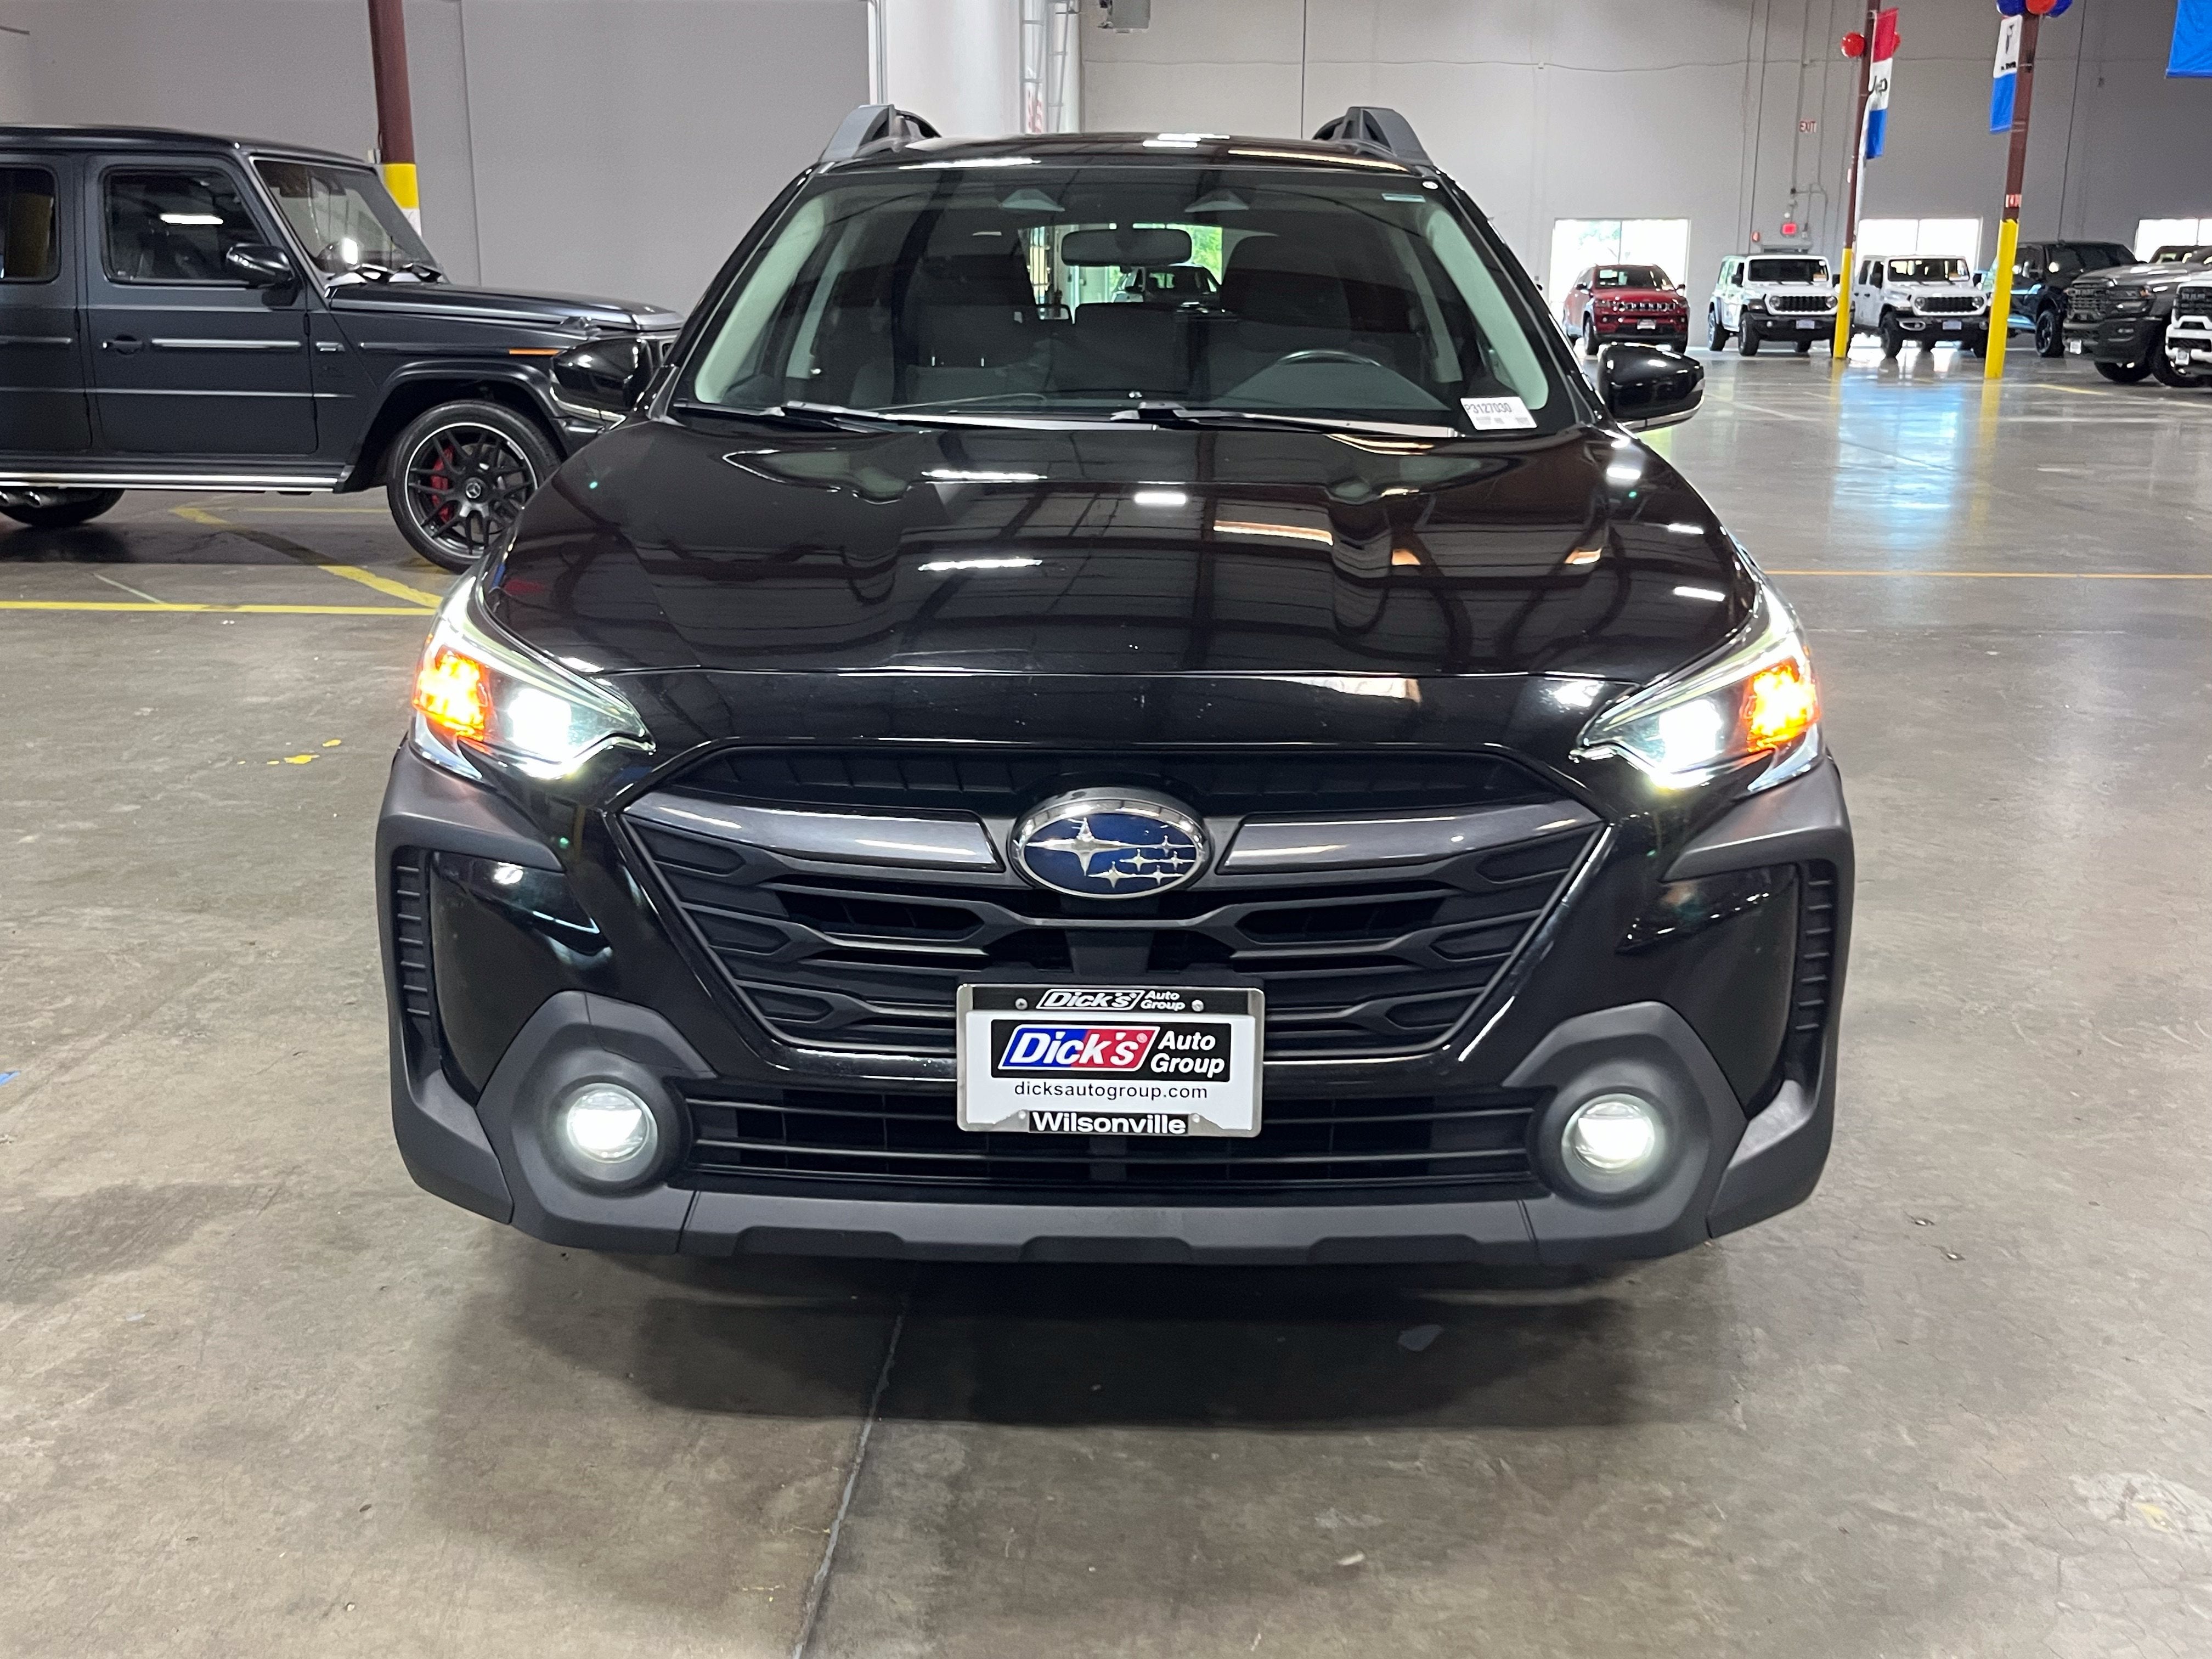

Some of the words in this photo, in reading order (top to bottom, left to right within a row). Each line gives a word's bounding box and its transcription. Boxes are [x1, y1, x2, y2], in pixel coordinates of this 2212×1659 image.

[1043, 991, 1132, 1008] Dick's
[1145, 990, 1180, 1000] Auto
[1140, 1000, 1186, 1011] Group
[1009, 1031, 1138, 1065] Dick's
[1158, 1030, 1216, 1051] Auto
[1151, 1053, 1225, 1078] Group
[1014, 1081, 1207, 1101] dicksautogroup.com
[1032, 1111, 1186, 1134] Wilsonville
